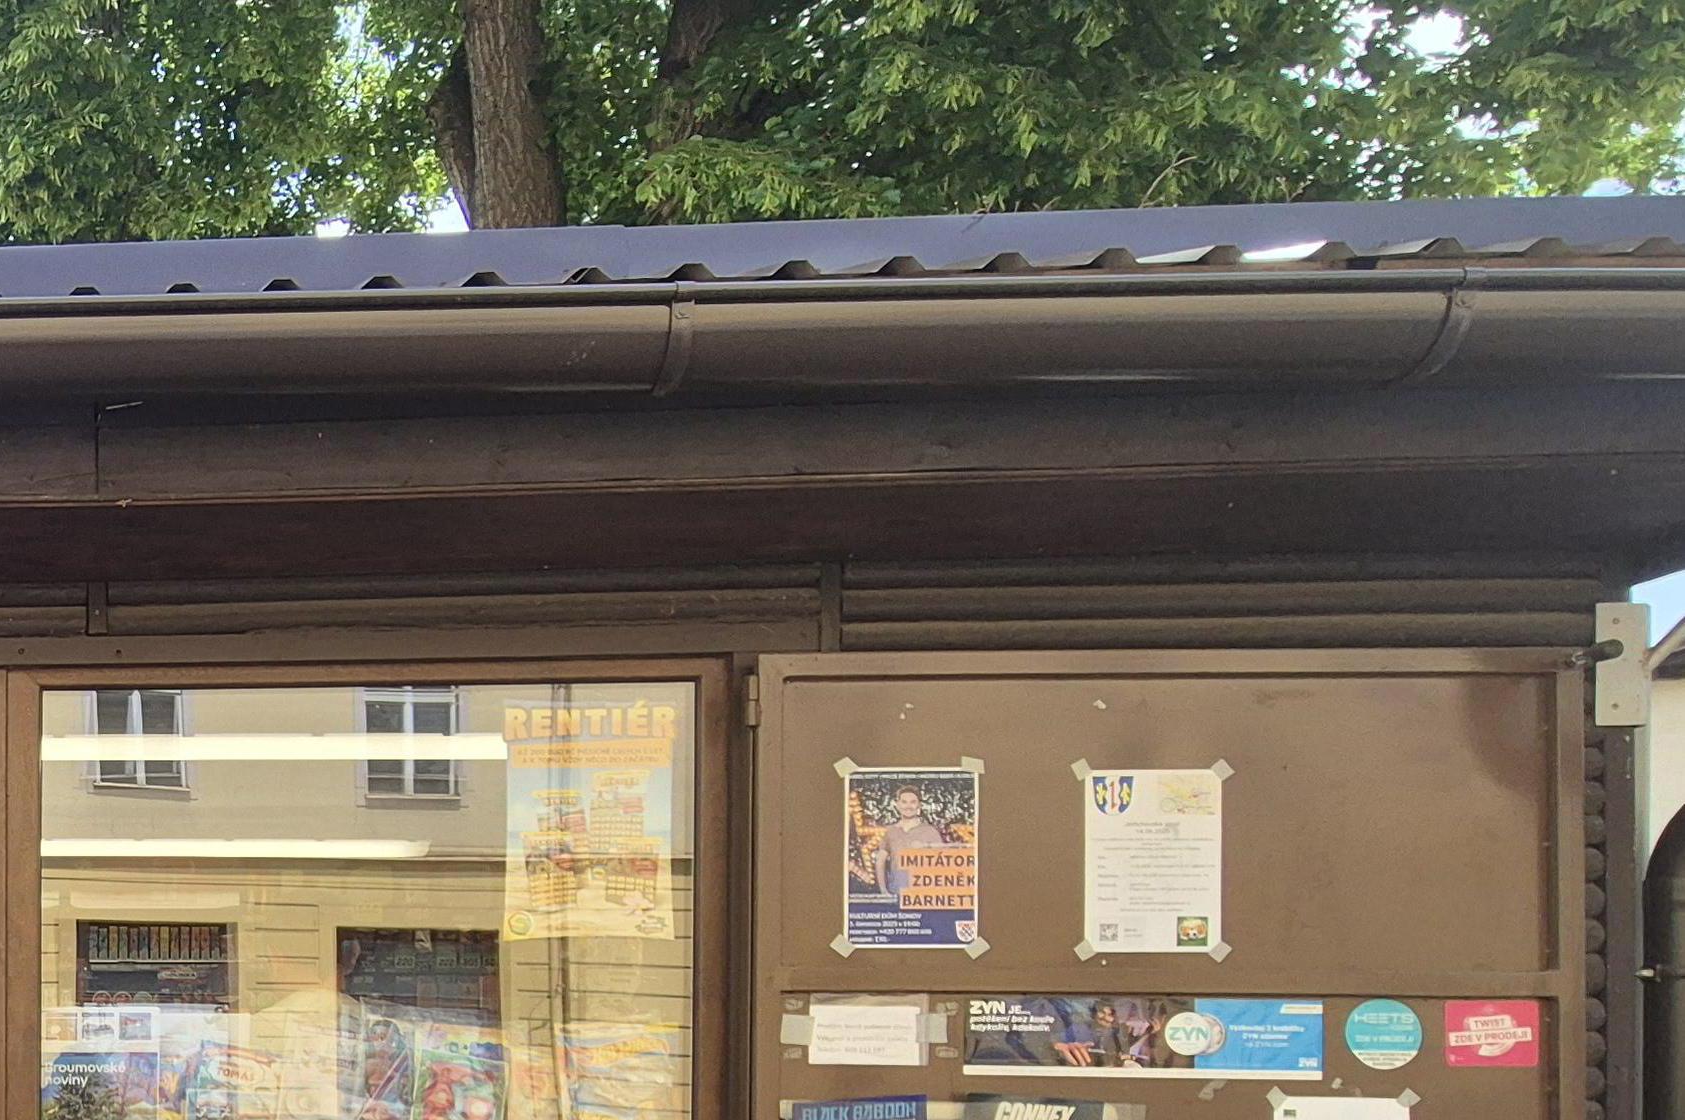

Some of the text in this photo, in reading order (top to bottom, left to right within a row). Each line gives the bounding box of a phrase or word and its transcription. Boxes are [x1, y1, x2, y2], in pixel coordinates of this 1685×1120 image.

[504, 700, 678, 741] RENTIÉR
[900, 851, 975, 867] IMITÁTOR
[912, 872, 975, 887] ZDENĚK
[902, 895, 974, 907] BARNETT
[969, 1000, 1006, 1014] ZYN
[1354, 1013, 1414, 1025] HEETS
[1473, 1018, 1506, 1029] TWIST
[1169, 1026, 1210, 1041] ZYN
[1454, 1031, 1528, 1044] ZDE V PRODEJI
